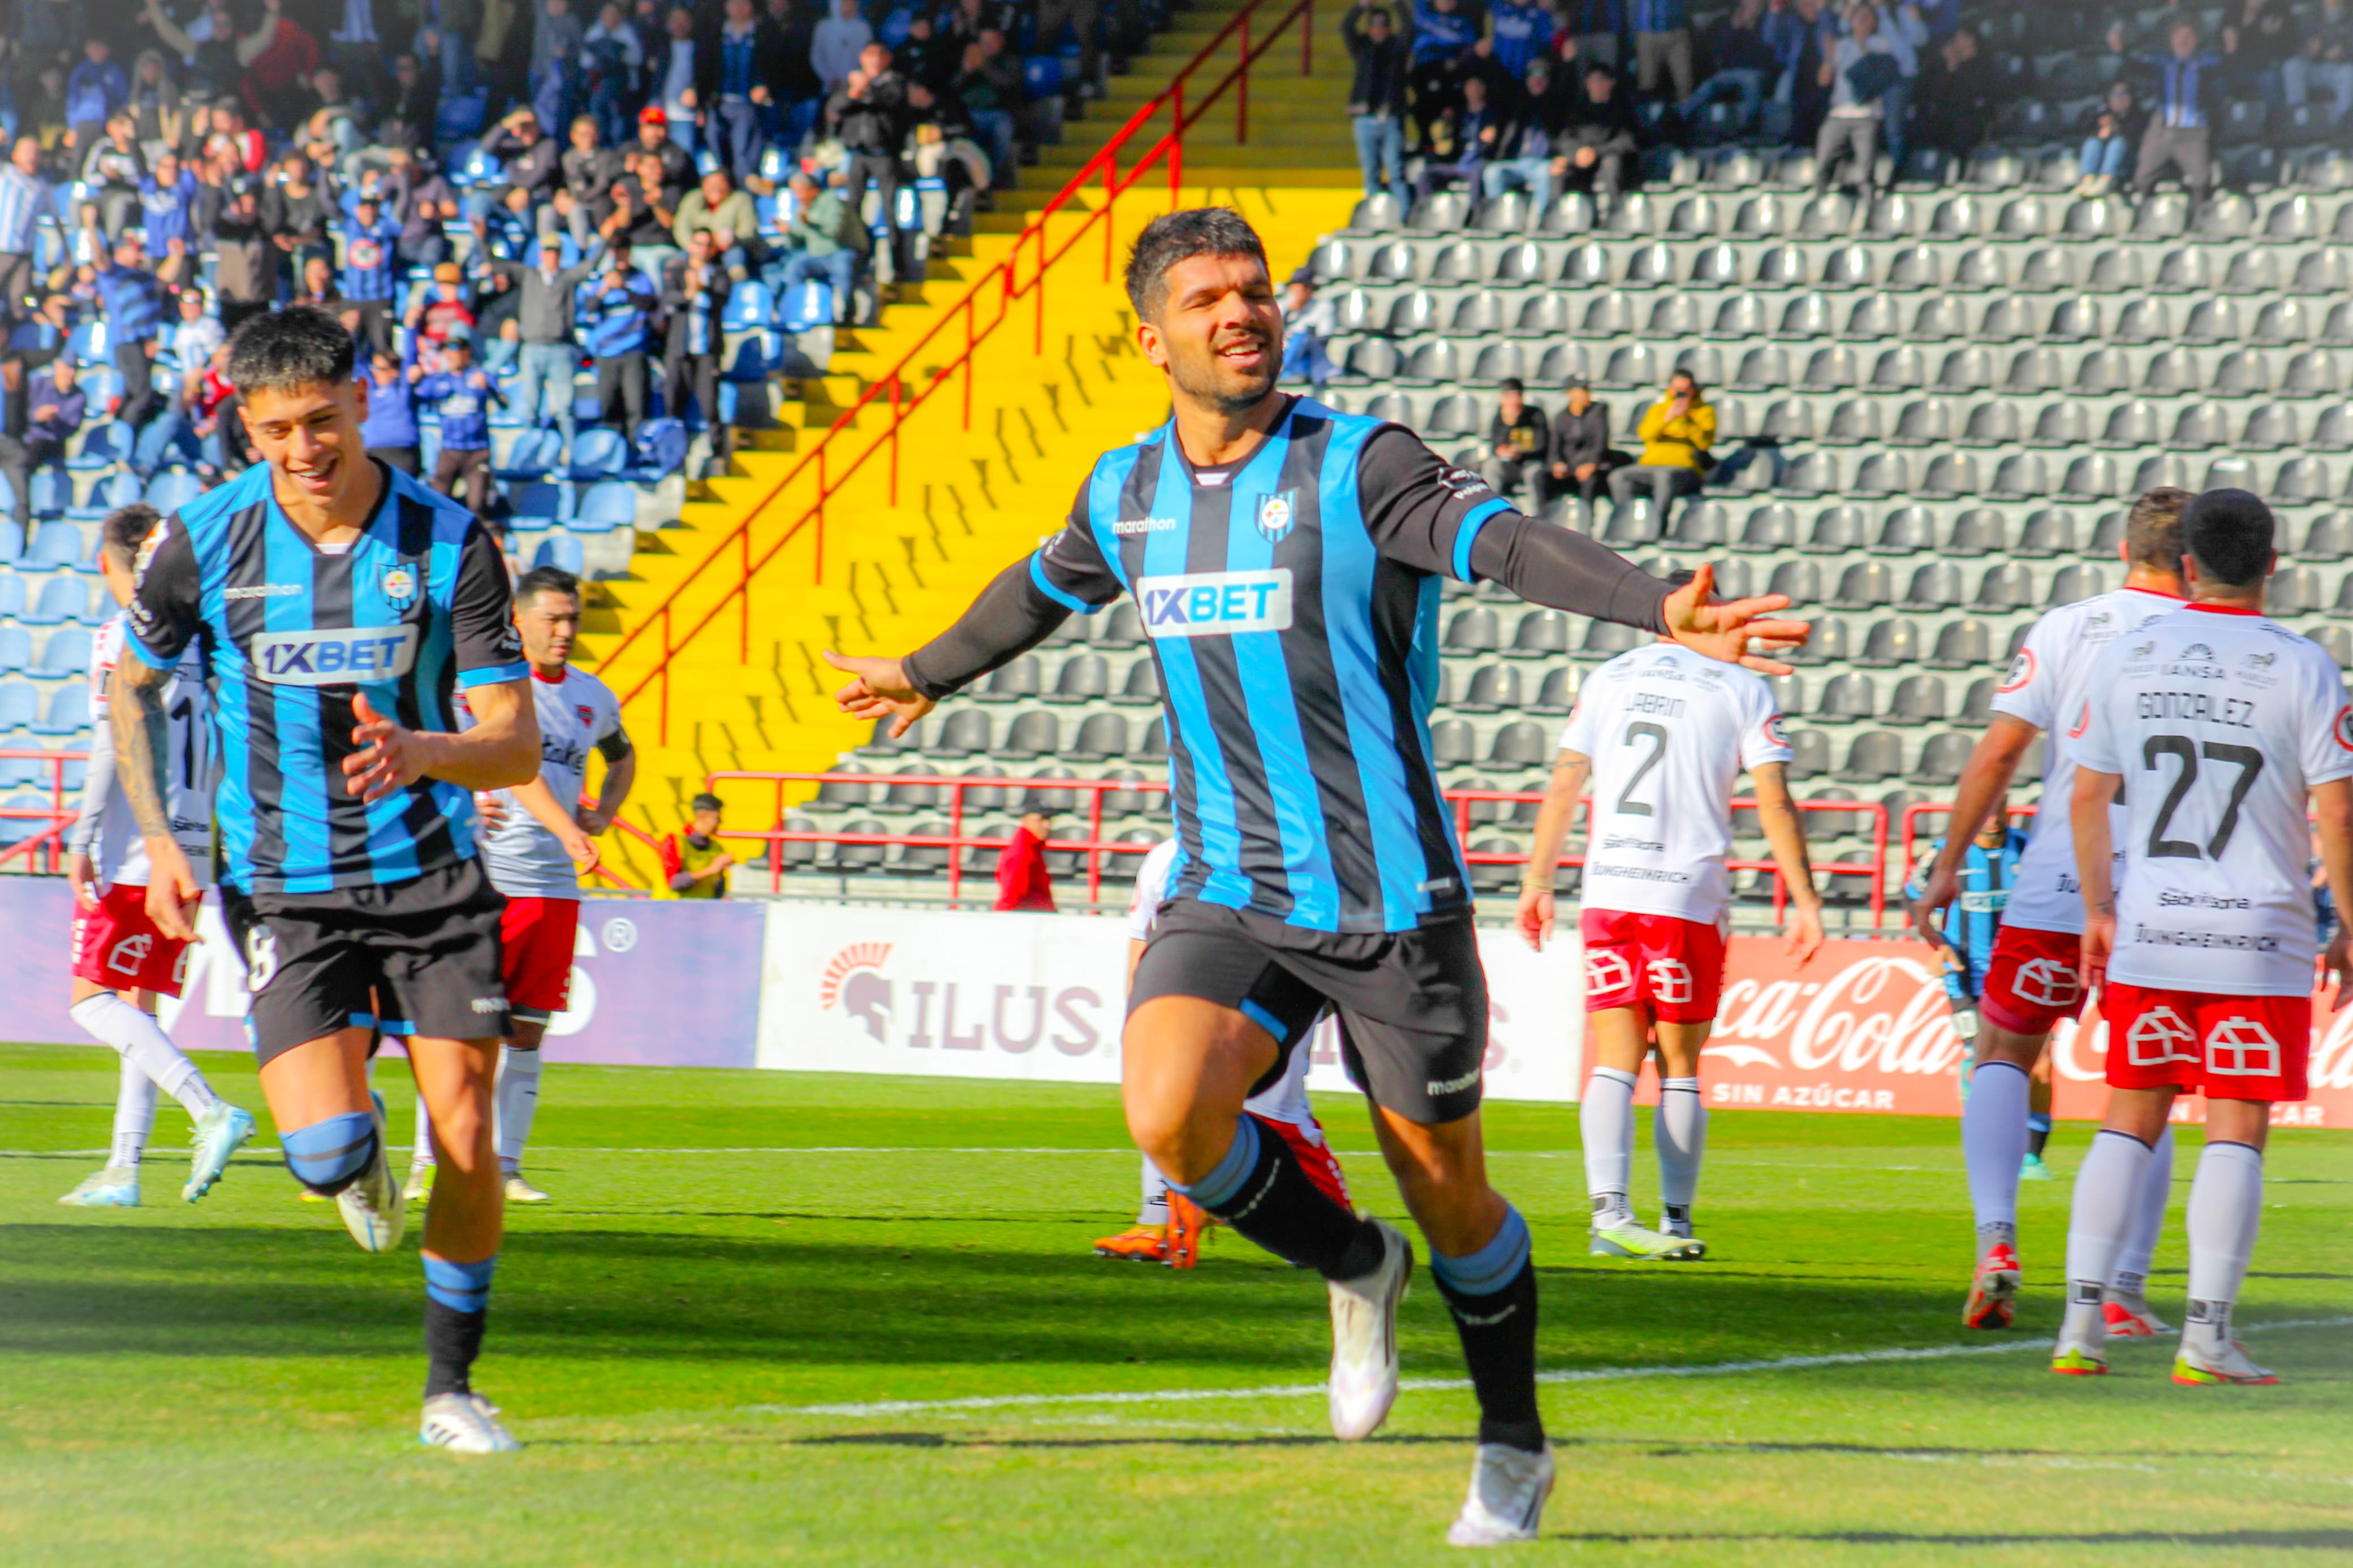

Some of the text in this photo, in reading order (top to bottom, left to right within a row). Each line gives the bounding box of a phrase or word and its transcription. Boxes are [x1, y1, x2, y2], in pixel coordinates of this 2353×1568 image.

[1112, 517, 1176, 533] marathon
[1145, 582, 1279, 625] 1XBET
[264, 636, 407, 674] 1XBET
[2137, 691, 2255, 728] GONZALEZ
[1617, 721, 1667, 817] 2
[2144, 735, 2264, 862] 27
[908, 981, 1103, 1057] ILUS
[1700, 956, 1964, 1075] ca-Cola
[1712, 1082, 1895, 1109] SIN AZÚCAR
